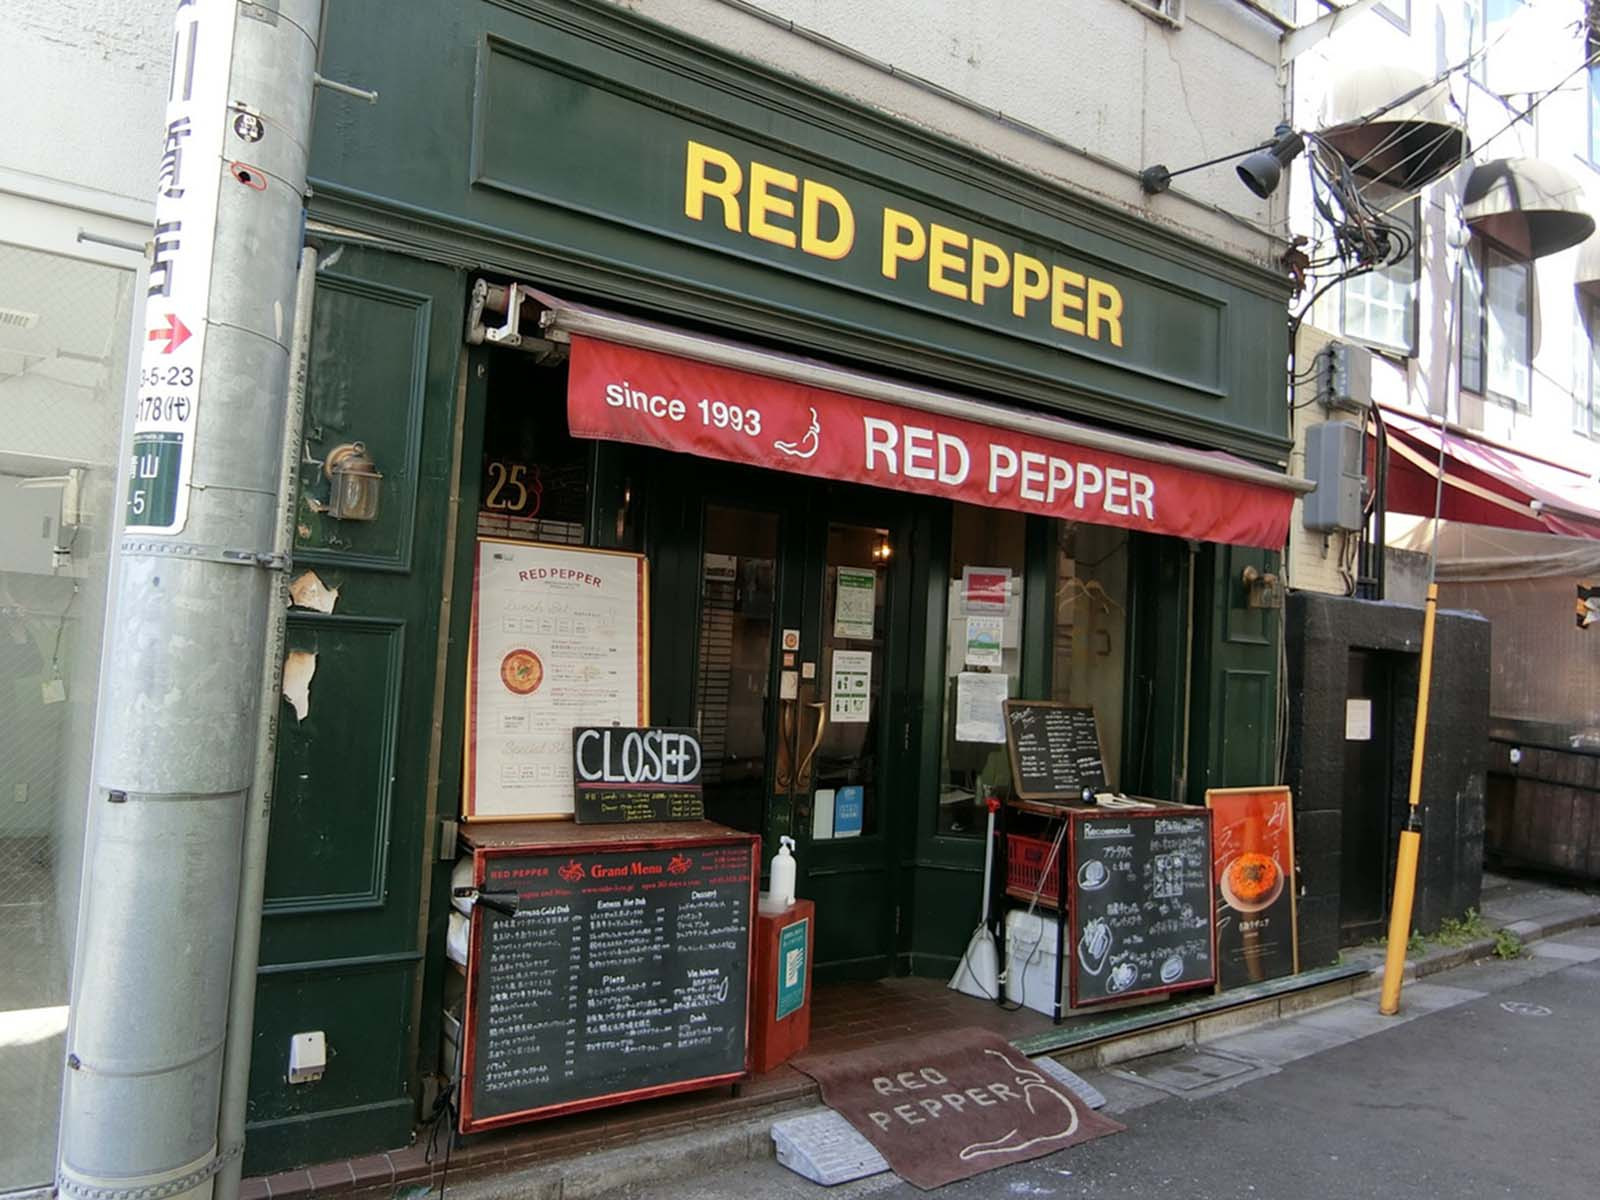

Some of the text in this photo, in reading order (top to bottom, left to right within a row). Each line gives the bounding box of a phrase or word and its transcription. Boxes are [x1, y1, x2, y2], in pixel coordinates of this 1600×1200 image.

[684, 139, 1124, 348] RED PEPPER
[606, 382, 762, 436] since 1993
[863, 416, 1155, 520] RED PEPPER
[518, 567, 547, 582] RED
[550, 567, 602, 588] PEPPER
[575, 728, 702, 785] CLOSED
[490, 867, 549, 879] RED PEPPER
[590, 862, 663, 878] Grand Menu
[868, 1067, 1022, 1133] RED PEPPER
